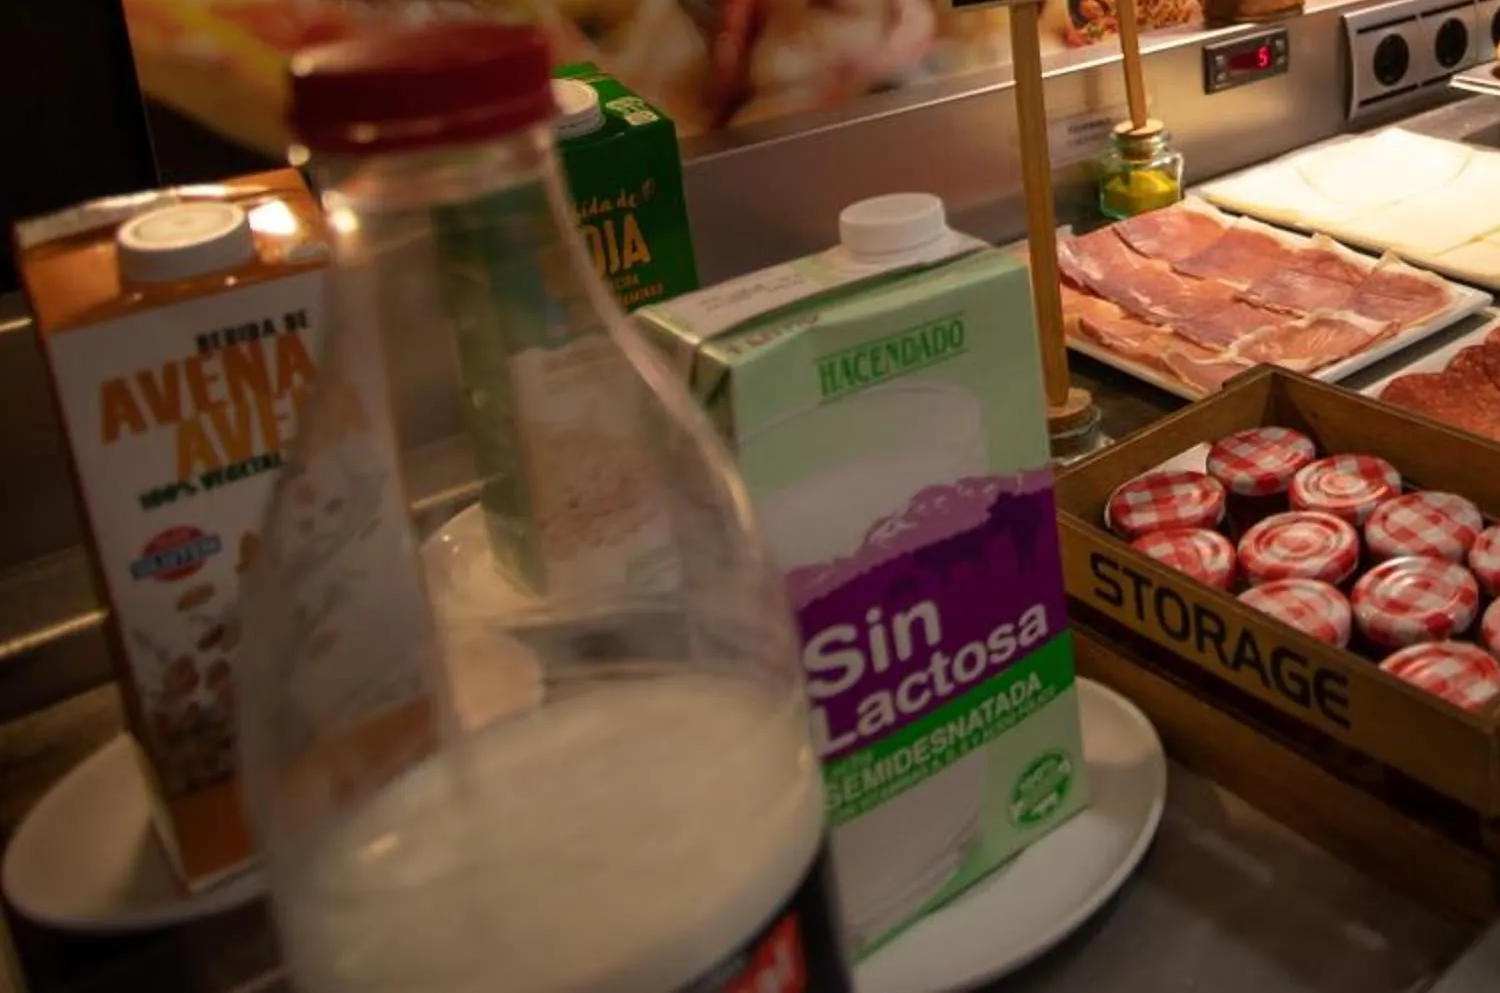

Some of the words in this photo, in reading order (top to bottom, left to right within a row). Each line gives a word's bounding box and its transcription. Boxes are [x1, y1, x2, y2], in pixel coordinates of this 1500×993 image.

[100, 329, 318, 446] AVENA
[816, 318, 966, 398] HACENDADO
[803, 600, 943, 699] Sin
[808, 603, 1050, 758] Lactosa
[1089, 551, 1353, 730] STORAGE
[826, 671, 1043, 808] SEMIDESNATADA
